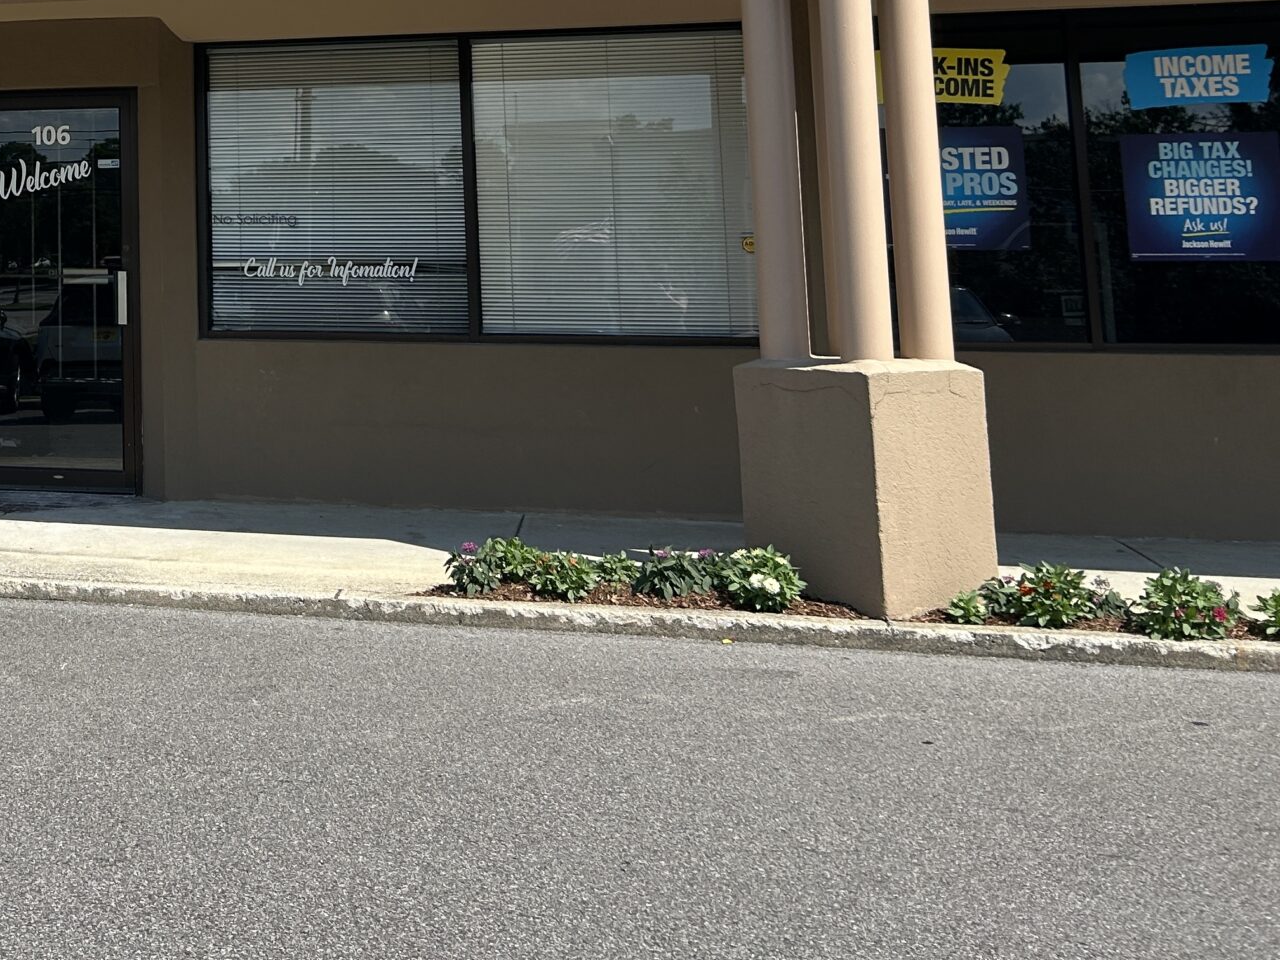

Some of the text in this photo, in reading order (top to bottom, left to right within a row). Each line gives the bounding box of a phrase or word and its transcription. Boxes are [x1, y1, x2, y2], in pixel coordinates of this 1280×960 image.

[1154, 54, 1251, 77] INCOME
[1160, 76, 1240, 98] TAXES
[31, 125, 71, 146] 106
[942, 147, 1009, 170] STED
[1158, 141, 1241, 160] BIG TAX
[0, 158, 92, 200] Welcome
[1148, 160, 1253, 178] CHANGES!
[946, 172, 1018, 196] PROS
[1164, 178, 1241, 197] BIGGER
[1150, 197, 1259, 215] REFUNDS?
[213, 213, 233, 225] No
[1183, 218, 1228, 232] Ask us!
[1182, 240, 1210, 248] Jackson
[243, 256, 277, 278] Call
[279, 264, 297, 278] us
[298, 260, 325, 287] for
